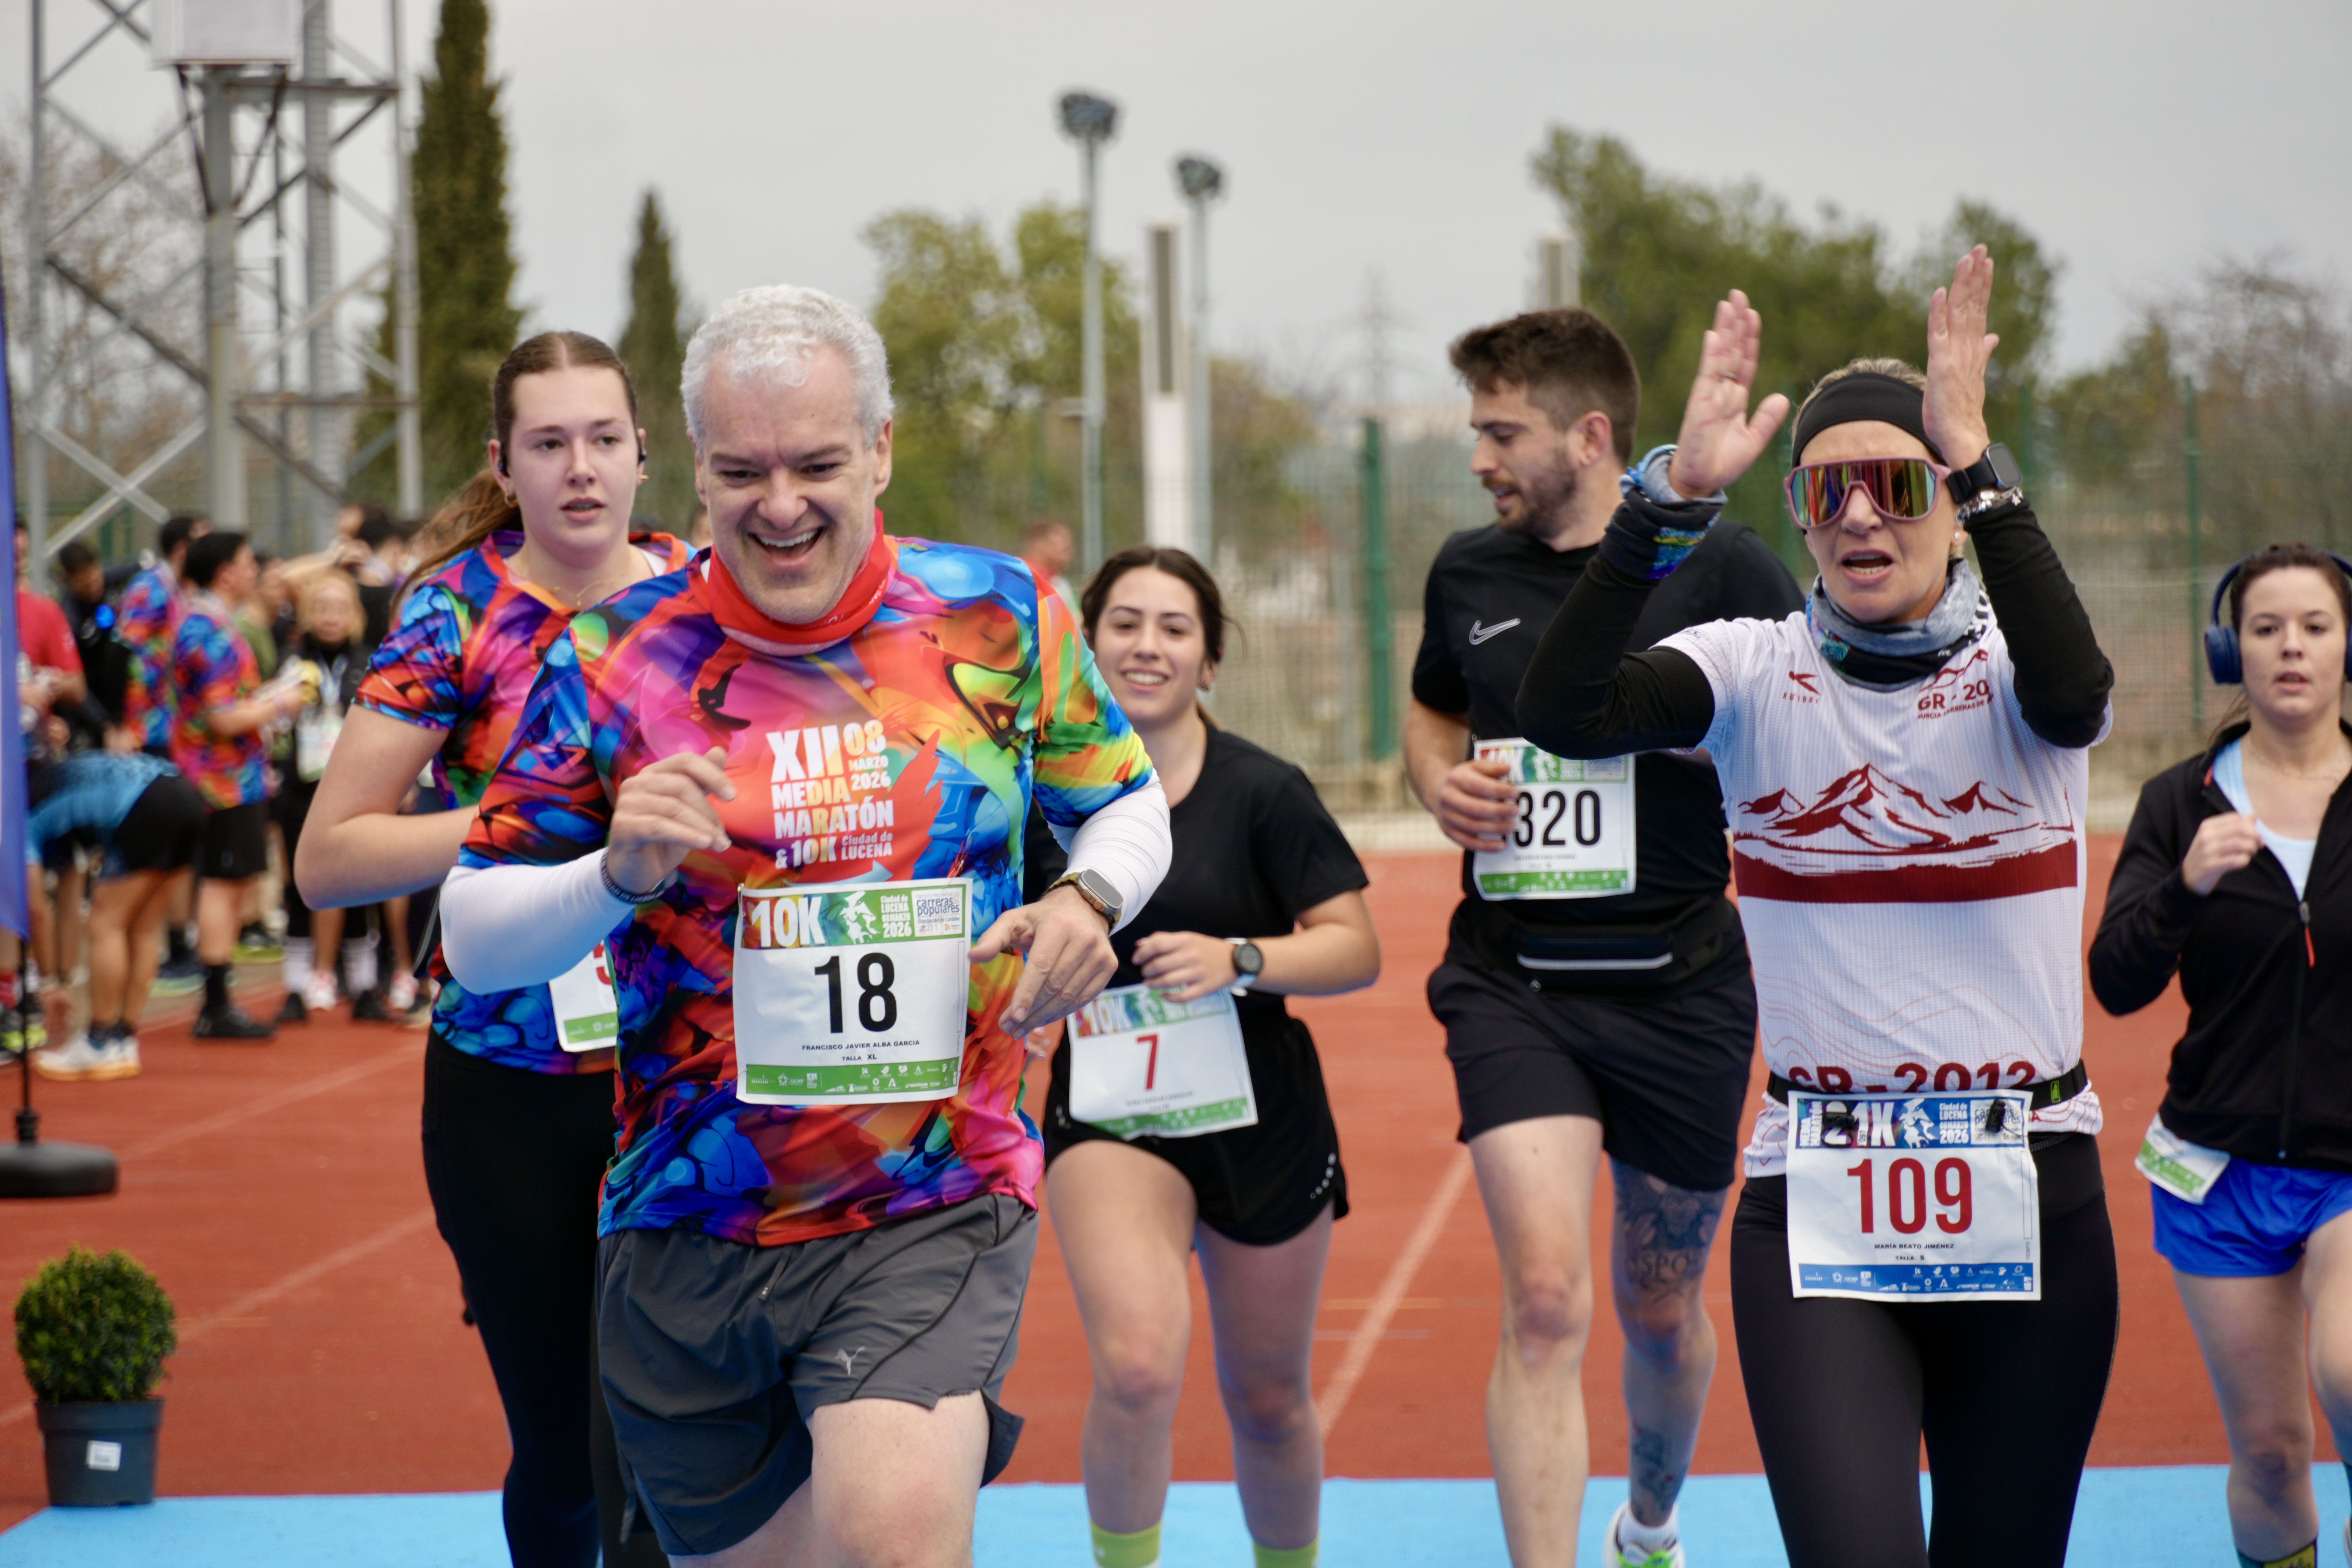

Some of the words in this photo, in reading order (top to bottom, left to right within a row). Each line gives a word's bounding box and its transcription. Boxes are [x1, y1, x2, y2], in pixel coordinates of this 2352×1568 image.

[1918, 693, 1945, 711] GR
[766, 725, 844, 783] XII
[843, 720, 887, 756] 08
[848, 755, 889, 772] MARZO
[851, 771, 891, 791] 2026
[771, 777, 851, 810] MEDIA
[774, 795, 894, 839] MARATÓN
[1500, 790, 1600, 847] 320
[842, 832, 878, 846] Ciudad
[880, 831, 893, 841] de
[775, 848, 788, 869] &
[791, 836, 838, 868] 10K
[841, 842, 893, 861] LUCENA
[881, 894, 900, 903] Ciudad
[917, 897, 953, 907] carreras
[881, 902, 909, 914] LUCENA
[918, 903, 959, 918] populares
[752, 896, 825, 947] 10K
[883, 922, 912, 938] 2026
[814, 952, 897, 1034] 18
[1136, 1033, 1159, 1092] 7
[1939, 1110, 1968, 1121] LUCENA
[1975, 1108, 2014, 1117] caras
[1975, 1115, 2020, 1126] poares
[1824, 1101, 1896, 1146] 21K
[1940, 1129, 1969, 1144] 2026
[1847, 1157, 1973, 1234] 109
